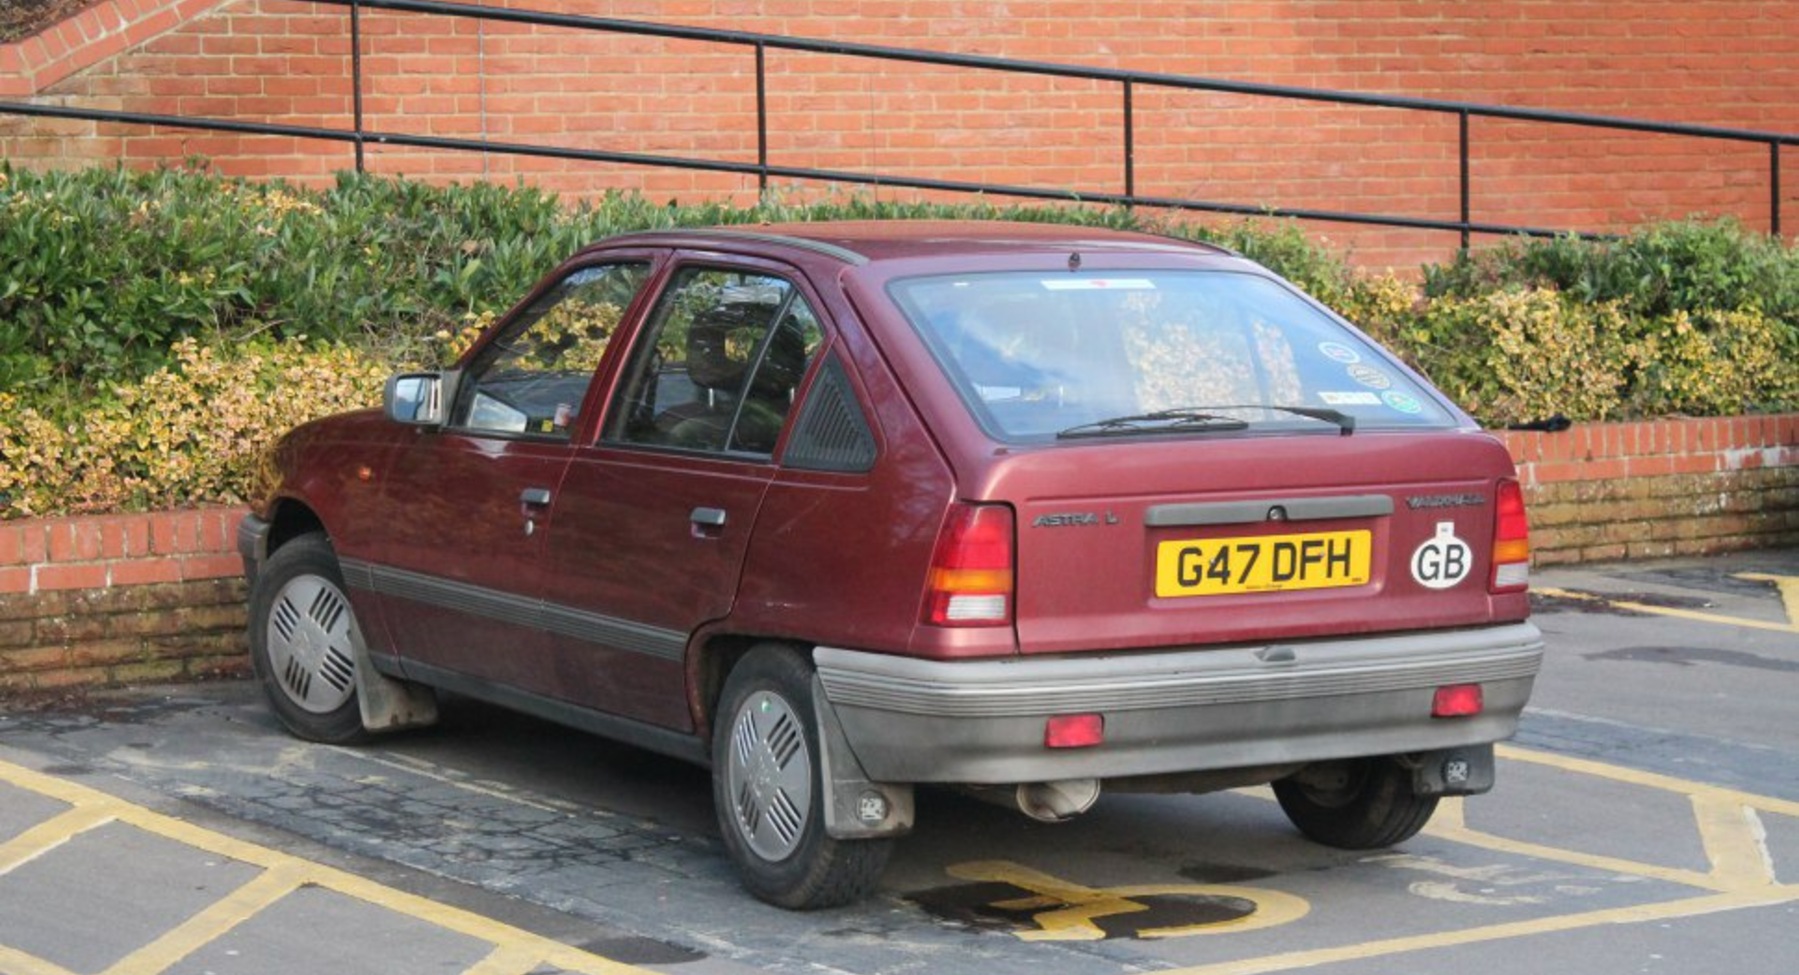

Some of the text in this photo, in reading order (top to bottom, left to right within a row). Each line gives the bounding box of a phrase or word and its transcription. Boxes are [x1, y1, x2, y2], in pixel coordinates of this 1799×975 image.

[1032, 509, 1119, 528] ASTRA L
[1177, 538, 1351, 587] G47 DFH
[1417, 544, 1464, 581] GB
